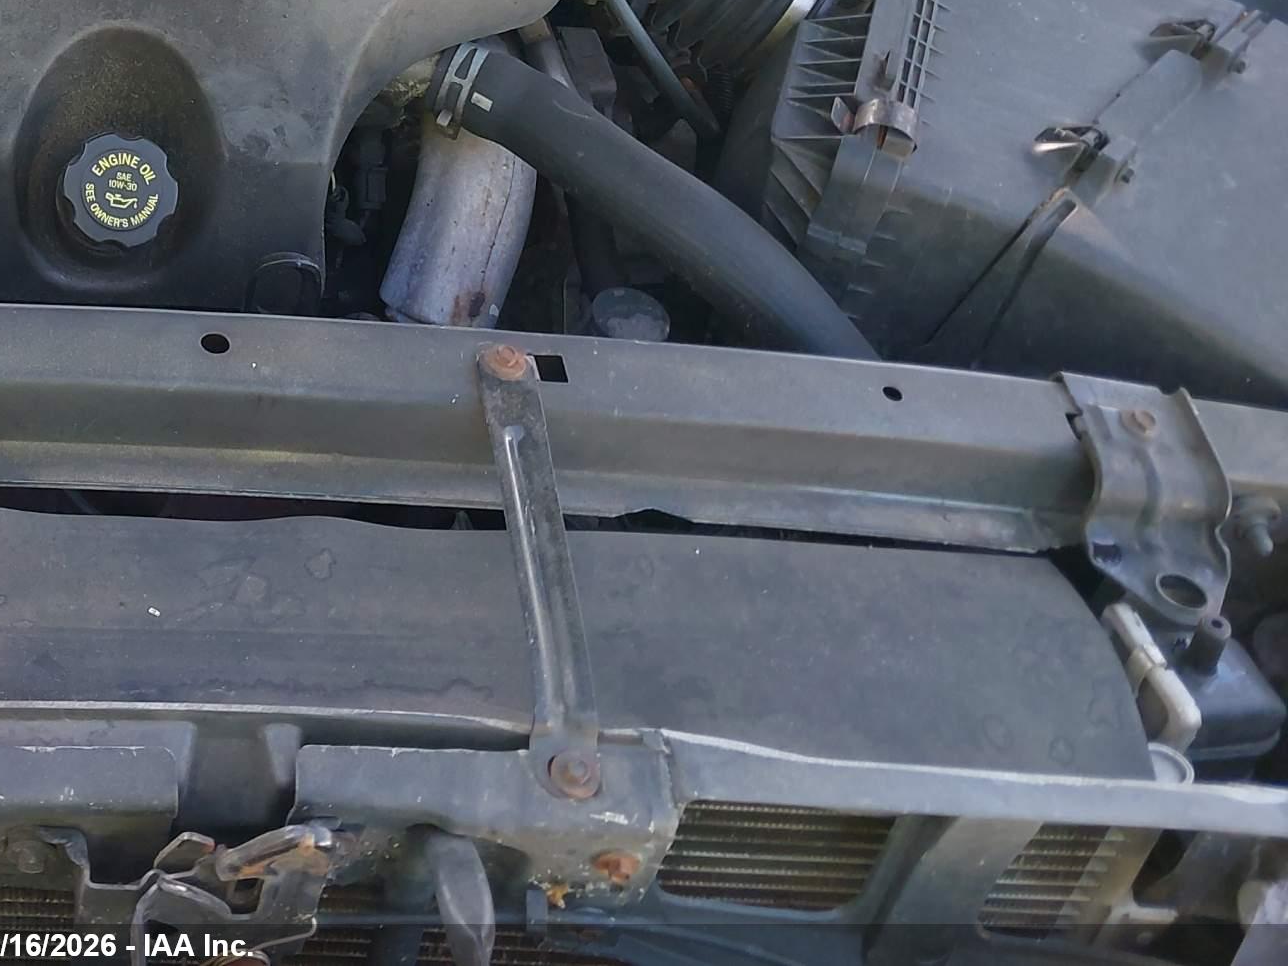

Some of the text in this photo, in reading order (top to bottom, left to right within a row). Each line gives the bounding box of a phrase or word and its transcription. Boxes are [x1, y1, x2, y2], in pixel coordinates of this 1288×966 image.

[91, 152, 157, 186] ENGINE OIL
[116, 171, 133, 182] SAE
[108, 179, 138, 192] 10W-30
[85, 182, 159, 228] SEE OWNER'S MANUAL
